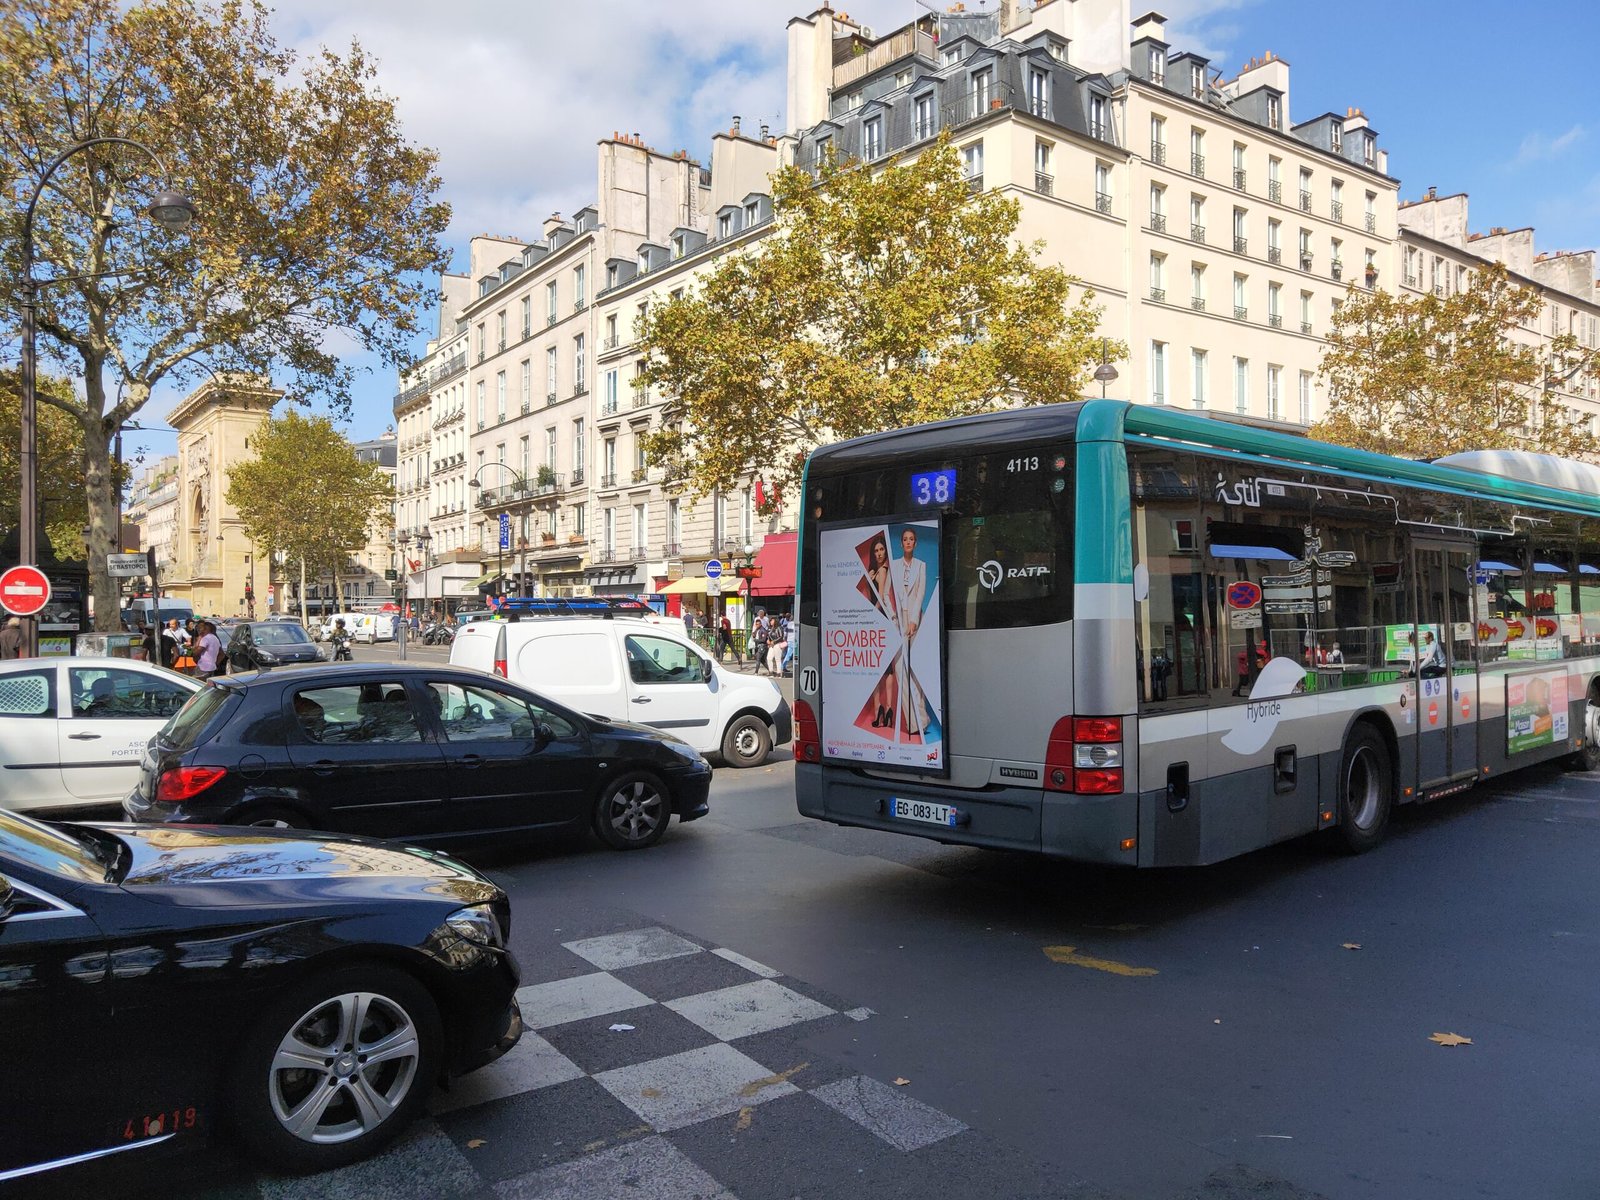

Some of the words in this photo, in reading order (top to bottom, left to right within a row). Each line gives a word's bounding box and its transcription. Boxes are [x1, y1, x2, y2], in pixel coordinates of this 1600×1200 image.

[1007, 457, 1039, 473] 4113
[917, 475, 949, 505] 38
[1008, 566, 1050, 579] RATP
[826, 630, 886, 648] L'OMBRE
[829, 650, 883, 668] D'EMILY
[804, 670, 816, 692] 70
[1247, 700, 1281, 723] Hybride
[1002, 768, 1036, 778] HYBRID
[897, 801, 949, 822] EG-083-LT
